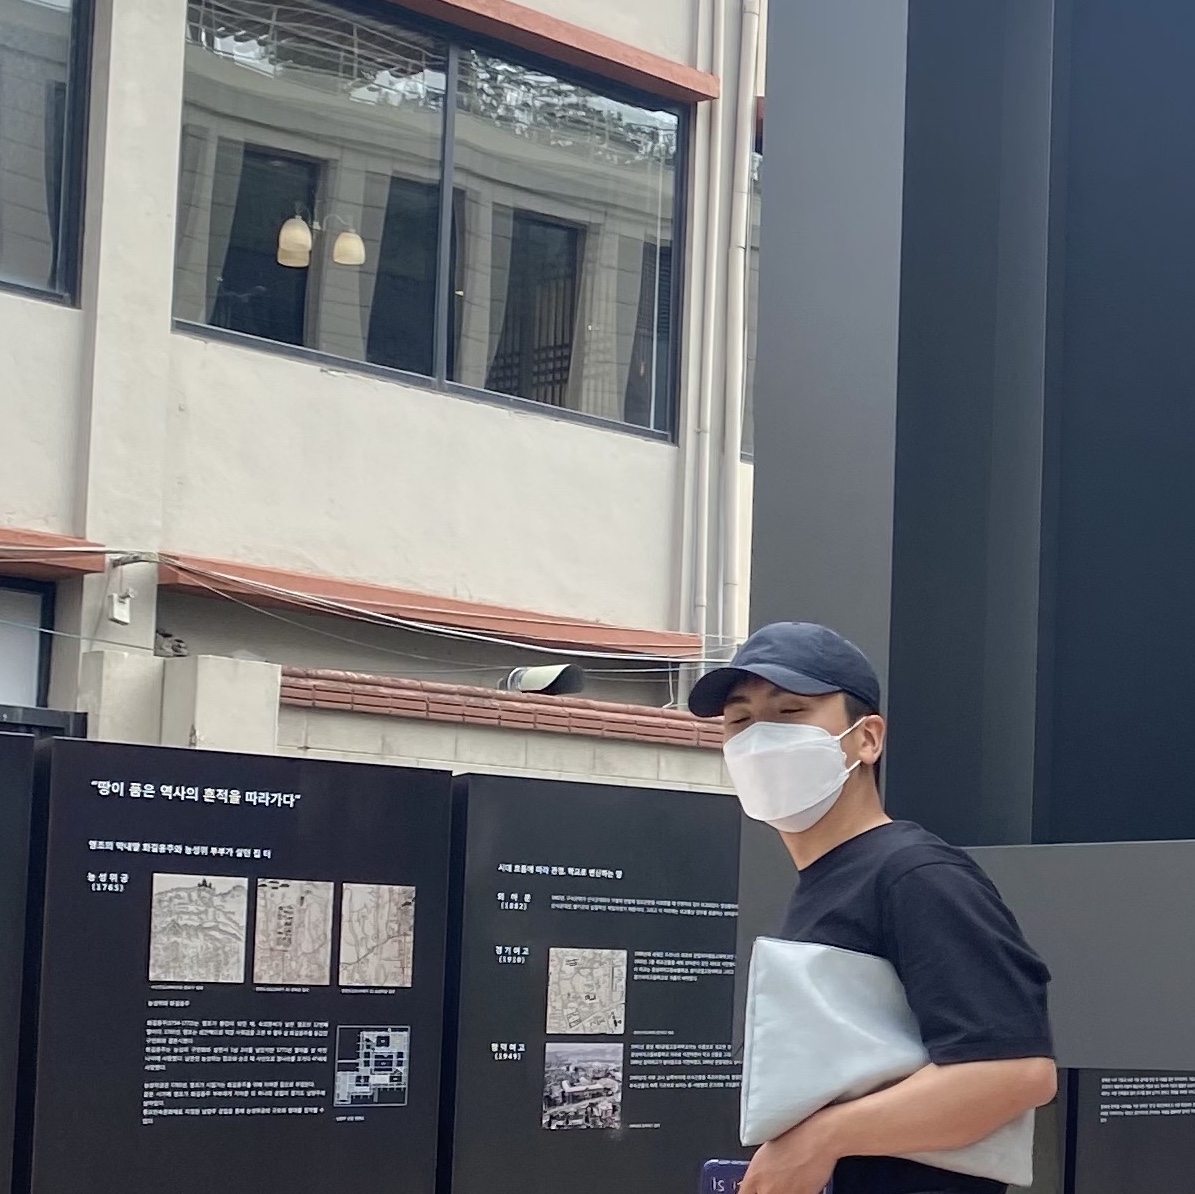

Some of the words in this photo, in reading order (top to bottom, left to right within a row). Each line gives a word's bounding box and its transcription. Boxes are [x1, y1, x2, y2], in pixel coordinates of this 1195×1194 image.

[128, 783, 156, 799] 품은
[159, 785, 199, 802] 역사의
[202, 788, 242, 805] 흔적을
